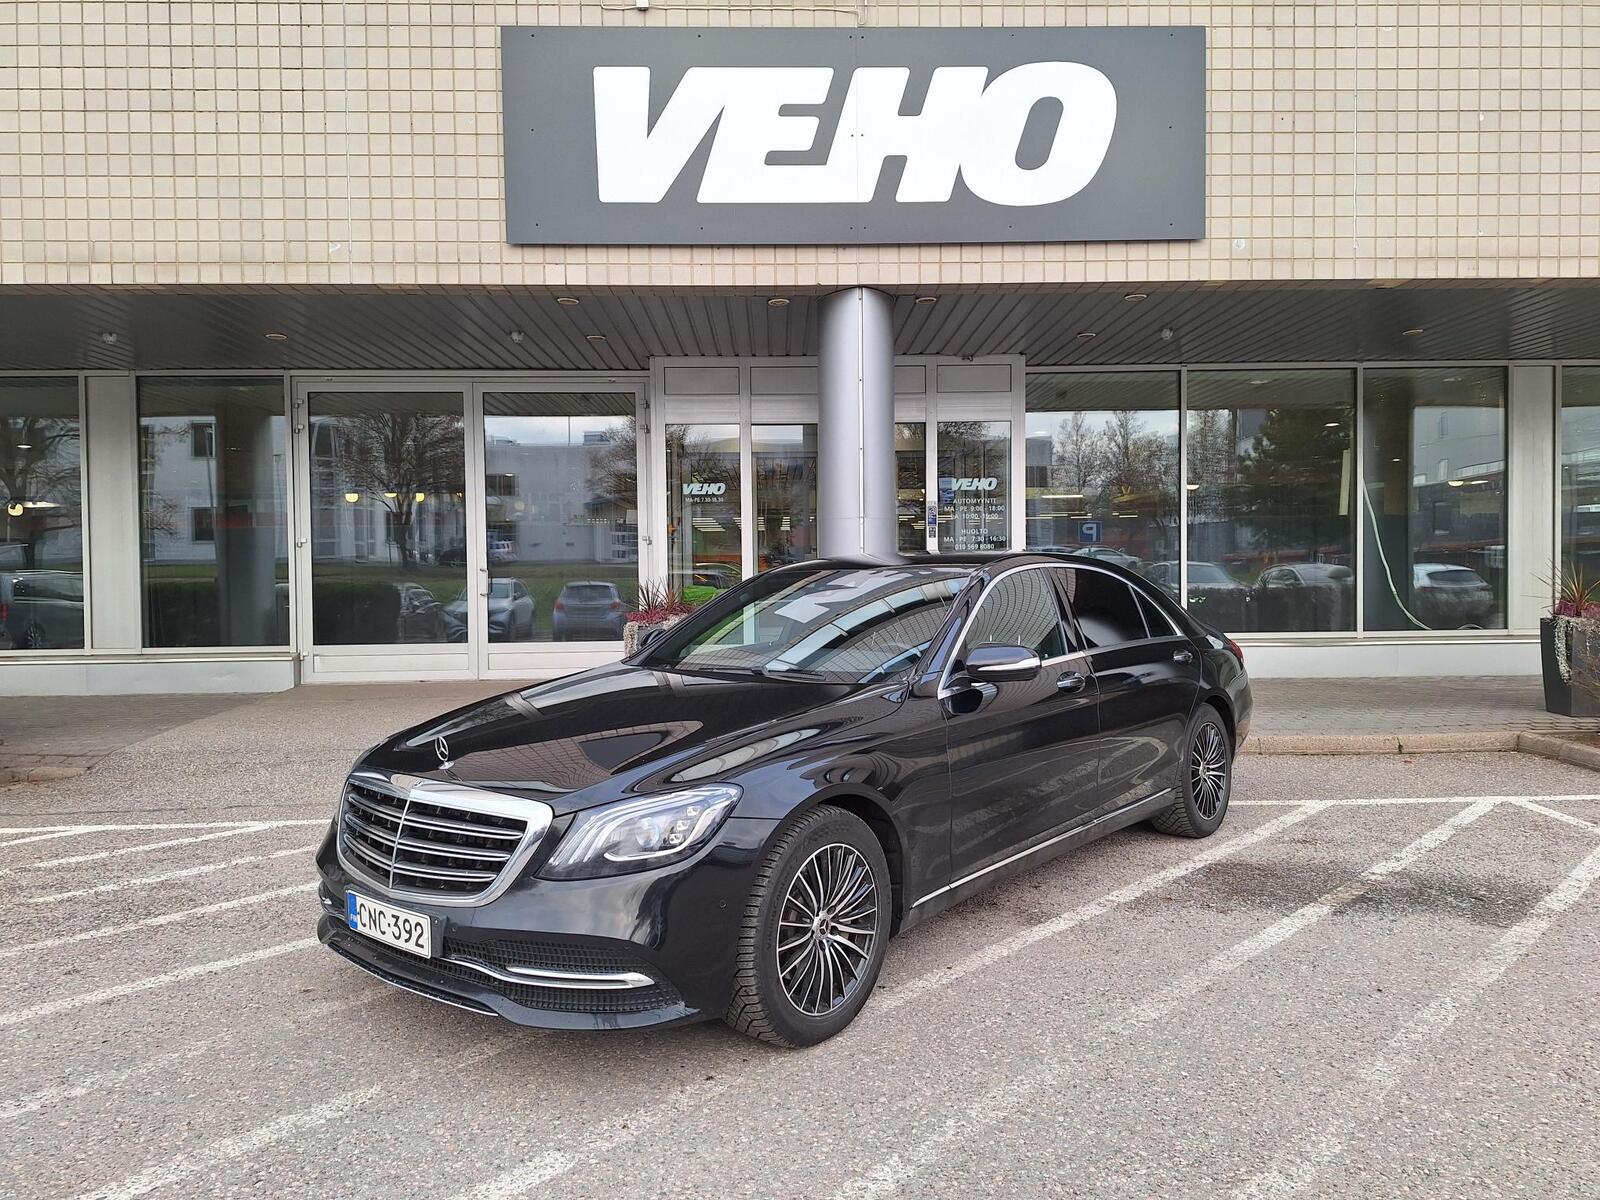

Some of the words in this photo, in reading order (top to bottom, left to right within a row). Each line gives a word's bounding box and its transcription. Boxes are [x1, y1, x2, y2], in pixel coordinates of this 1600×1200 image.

[593, 61, 1118, 206] VEHO
[682, 482, 726, 495] VEHO
[952, 477, 997, 491] VEHO
[359, 903, 425, 949] CNC-392
